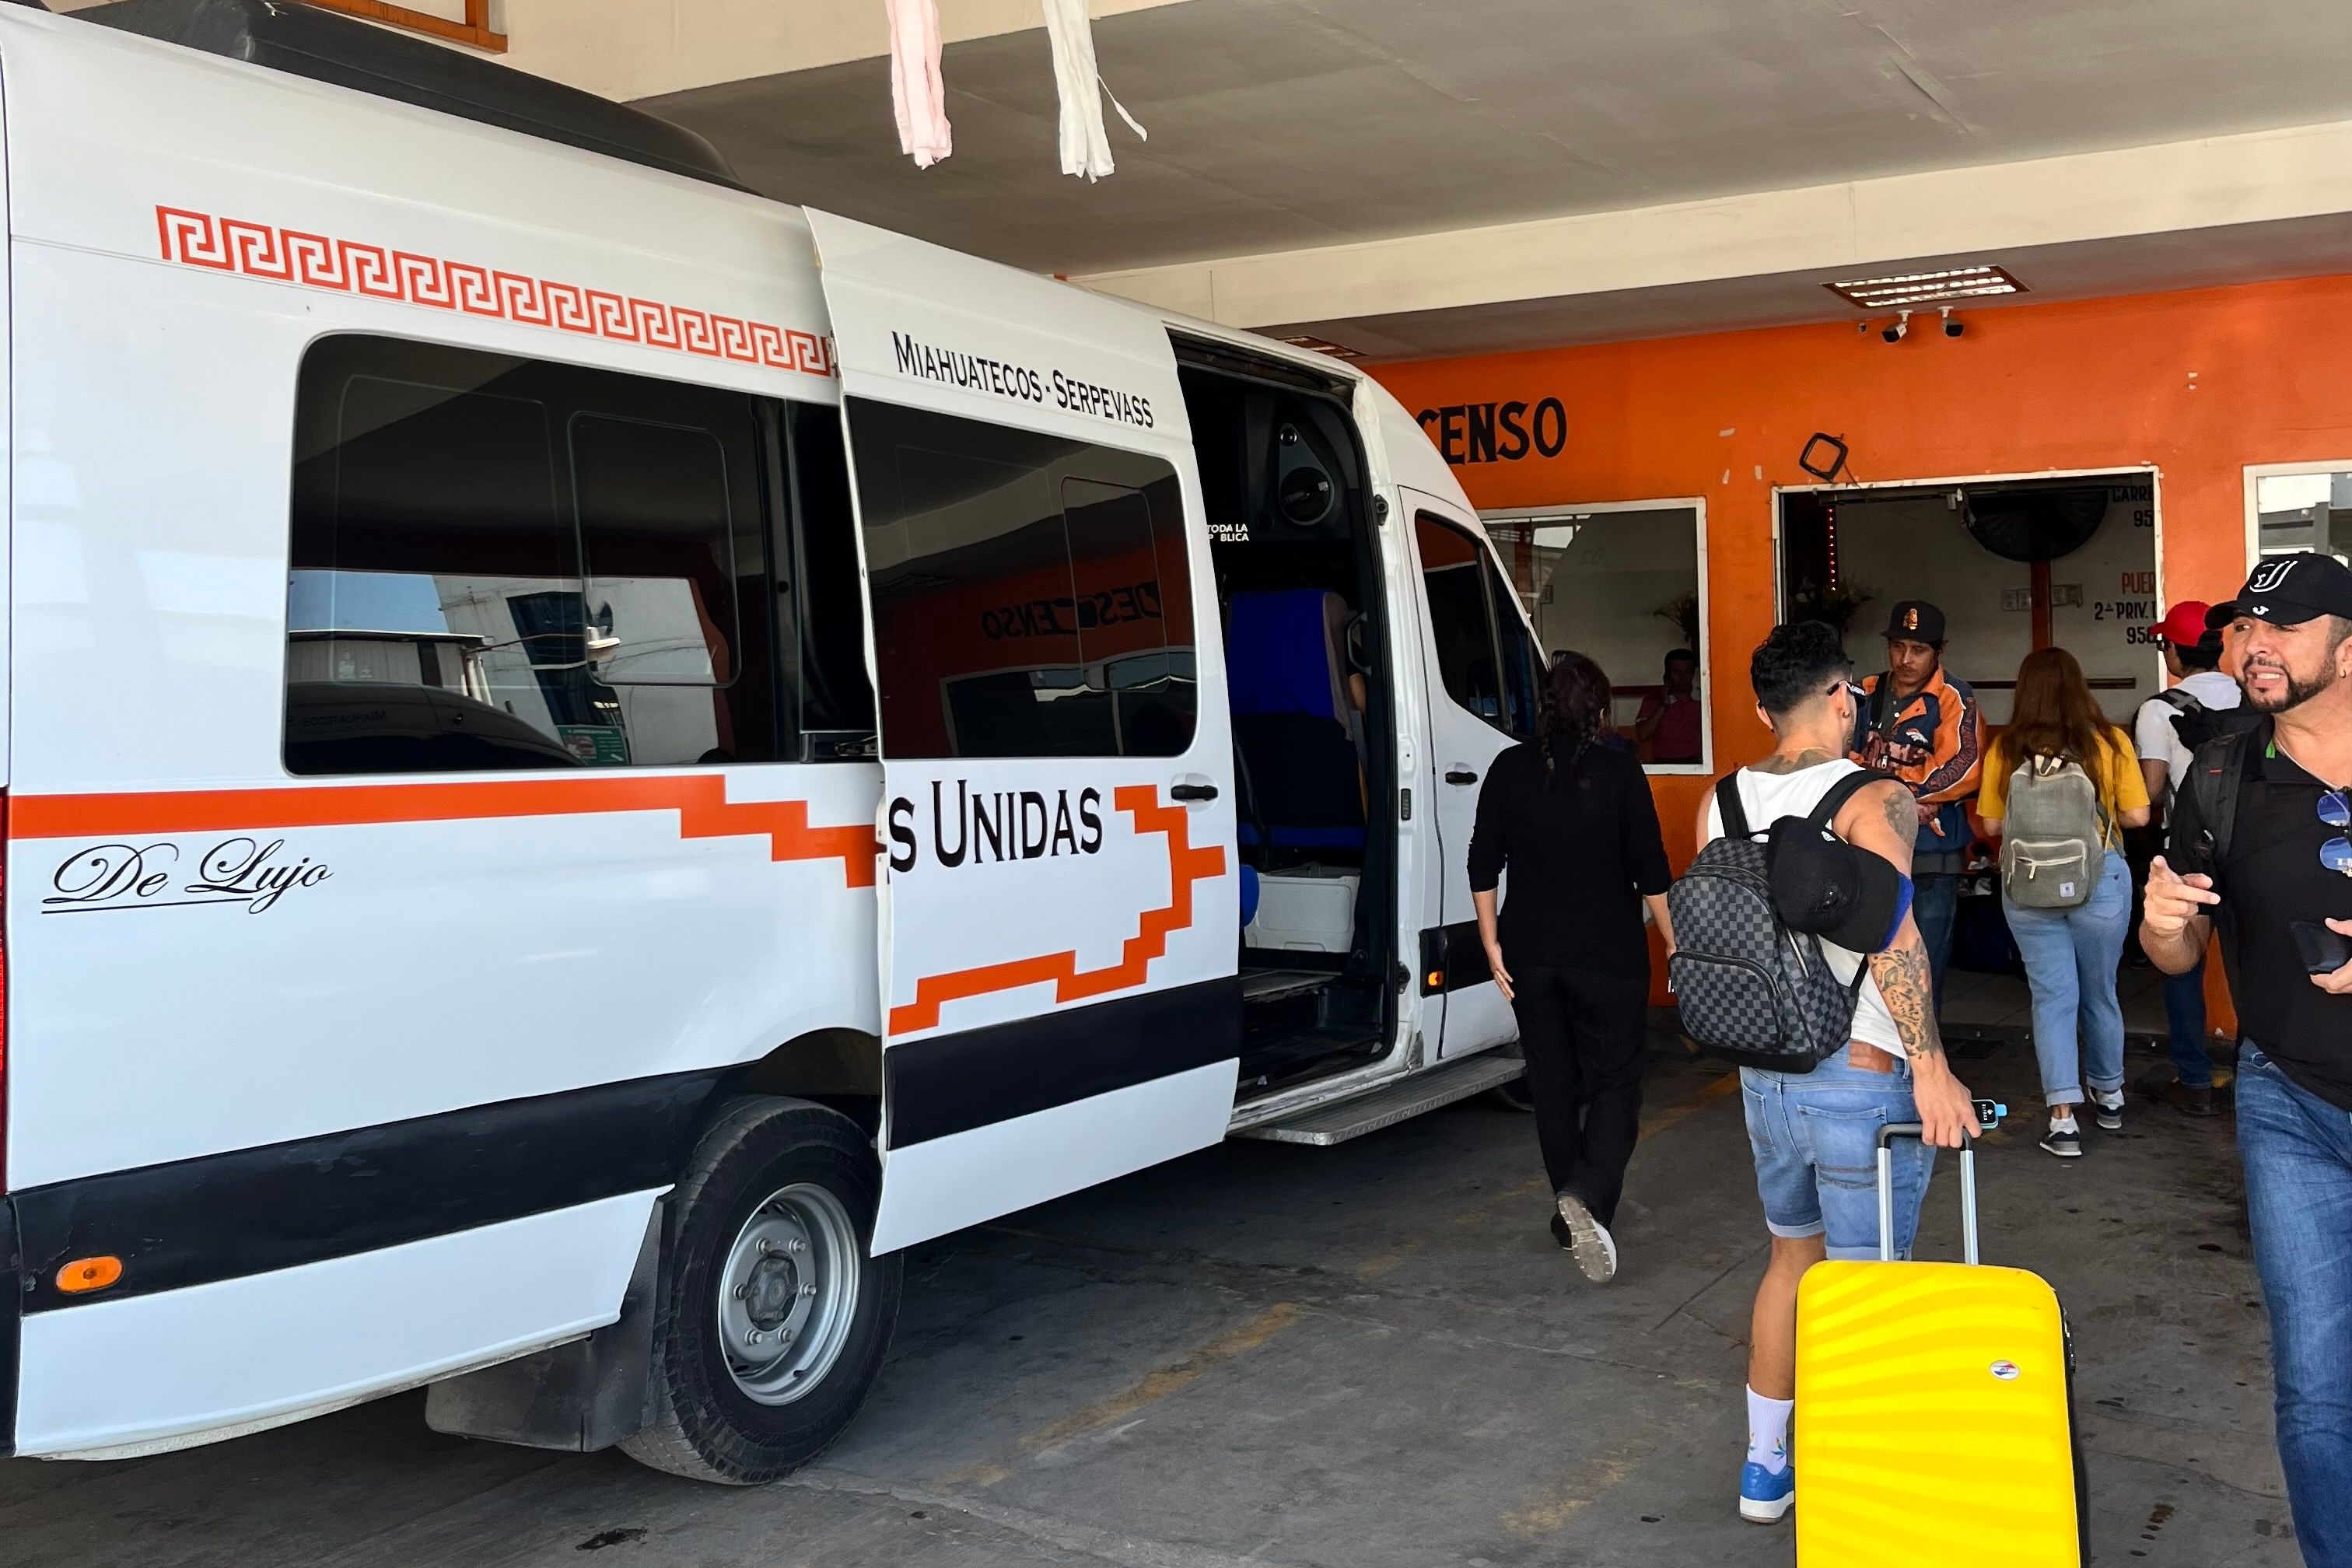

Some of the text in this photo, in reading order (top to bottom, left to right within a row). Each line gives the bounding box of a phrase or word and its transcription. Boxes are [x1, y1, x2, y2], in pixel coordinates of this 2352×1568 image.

[892, 331, 1043, 403] MIAHUATECOS
[1052, 369, 1154, 429] SERPEVASS
[1235, 523, 1248, 533] LA
[931, 779, 1103, 868] UNIDAS
[41, 837, 334, 915] De Lujo
